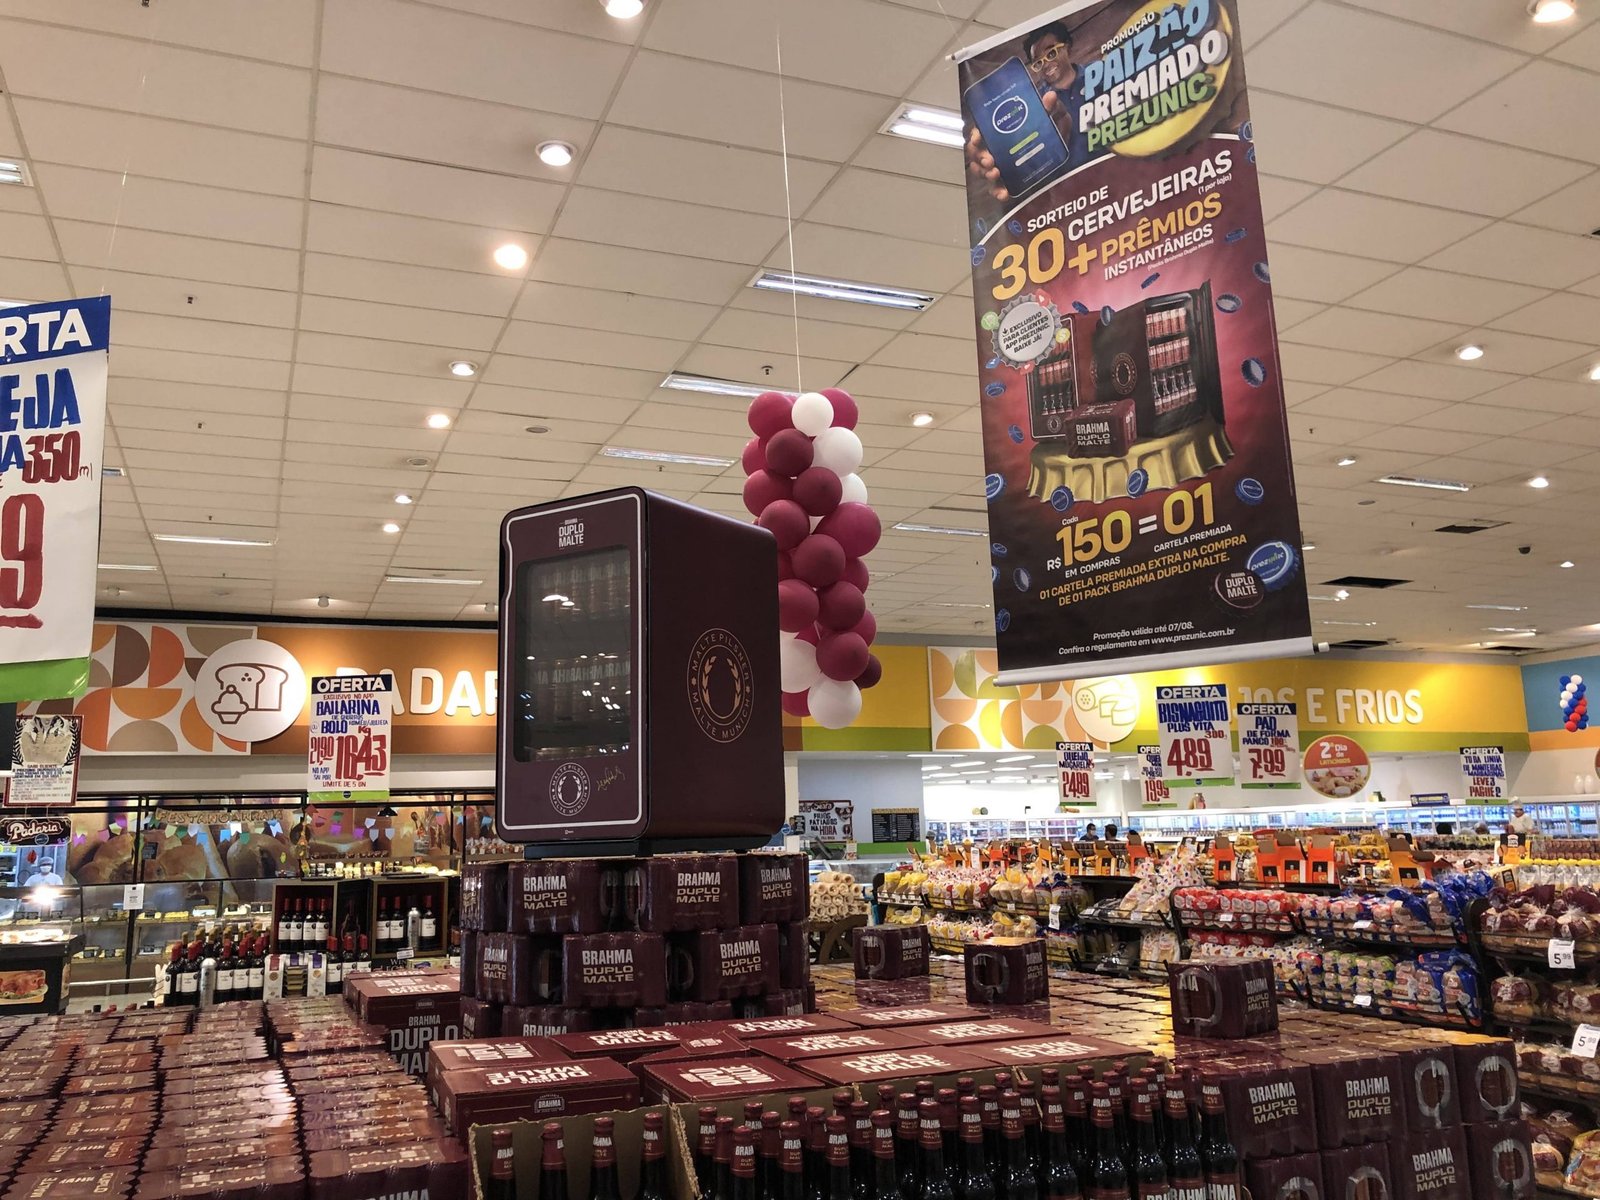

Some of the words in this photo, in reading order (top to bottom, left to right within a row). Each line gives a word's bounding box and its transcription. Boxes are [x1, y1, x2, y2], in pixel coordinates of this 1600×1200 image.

[1101, 12, 1155, 54] PROMOÇÃO
[1080, 30, 1228, 132] PREMIADO
[1088, 73, 1213, 152] PREZUNIC
[1067, 150, 1233, 242] CERVEJEIRAS
[1027, 195, 1088, 233] SORTEIO
[1090, 185, 1109, 207] DE
[1102, 192, 1223, 265] PRÊMIOS
[1104, 224, 1213, 281] INSTANTÂNEOS
[991, 226, 1065, 301] 30
[1003, 331, 1020, 344] PARA
[1020, 315, 1049, 335] CLIENTES
[1010, 311, 1042, 334] EXCLUSIVO
[1005, 339, 1018, 350] APP
[1014, 339, 1032, 353] BAIXE
[1075, 421, 1110, 435] BRAHMA
[1077, 433, 1110, 442] DUPLO
[1077, 438, 1111, 447] MALTE
[1055, 510, 1132, 567] 150
[1162, 482, 1215, 535] 01
[1062, 515, 1079, 526] Cada
[559, 523, 584, 536] DUPLO
[559, 534, 584, 547] MALTE
[1153, 536, 1189, 553] CARTELA
[1190, 524, 1232, 544] PREMIADA
[1039, 589, 1050, 600] 01
[1051, 577, 1094, 596] CARTELA
[1095, 563, 1147, 586] PREMIADA
[1148, 553, 1182, 570] EXTRA
[1183, 549, 1199, 560] NA
[1200, 534, 1247, 556] COMPRA
[1047, 556, 1062, 571] R$
[1065, 569, 1077, 579] EM
[1080, 556, 1120, 575] COMPRAS
[1058, 596, 1072, 607] DE
[1072, 593, 1083, 603] 01
[1084, 585, 1110, 600] PACK
[1112, 572, 1156, 592] BRAHMA
[1157, 562, 1191, 580] DUPLO
[1192, 551, 1231, 570] MALTE.
[1225, 576, 1255, 589] DUPLO
[1227, 585, 1258, 598] MALTE
[1093, 630, 1130, 641] Promoção
[1131, 627, 1153, 637] válida
[1154, 625, 1167, 634] até
[1058, 645, 1085, 655] Confira
[1091, 639, 1138, 654] regulamento
[1151, 628, 1236, 644] www.prezunic.com.br
[692, 634, 717, 671] MALTE
[719, 634, 749, 680] PILSNER
[317, 678, 385, 693] OFERTA
[1161, 687, 1221, 699] OFERTA
[316, 700, 380, 716] BAILARINA
[1241, 705, 1291, 714] OFERTA
[1306, 688, 1327, 723] E
[1336, 689, 1424, 724] FRIOS
[692, 692, 717, 736] MALTE
[722, 699, 750, 738] MUNICH
[321, 720, 348, 734] BOLO
[1167, 722, 1190, 733] PLUS
[1194, 721, 1215, 731] VITA
[1247, 730, 1258, 738] DE
[1260, 730, 1291, 738] FORMA
[1473, 777, 1489, 785] LEVE
[10, 822, 58, 840] Padaria
[677, 872, 721, 886] BRAHMA
[761, 867, 791, 883] BRAHMA
[523, 876, 566, 891] BRAHMA
[762, 882, 792, 893] DUPLO
[523, 892, 567, 901] DUPLO
[676, 894, 720, 903] MALTE
[677, 887, 721, 896] DUPLO
[762, 890, 792, 900] MALTE
[524, 899, 568, 910] MALTE
[484, 947, 508, 963] BRAHMA
[719, 939, 760, 959] BRAHMA
[582, 949, 634, 965] BRAHMA
[721, 956, 761, 969] DUPLO
[483, 962, 507, 972] DUPLO
[583, 965, 634, 975] DUPLO
[722, 964, 761, 977] MALTE
[483, 970, 507, 980] MALTE
[583, 973, 634, 983] MALTE
[408, 1015, 441, 1027] BRAHMA
[523, 1024, 567, 1036] BRAHMA
[1249, 1081, 1295, 1104] BRAHMA
[1346, 1076, 1390, 1097] BRAHMA
[538, 1099, 562, 1109] BRAHMA
[1252, 1099, 1297, 1115] DUPLO
[1348, 1096, 1391, 1109] DUPLO
[1254, 1107, 1299, 1125] MALTE
[1348, 1105, 1391, 1119] MALTE
[1412, 1148, 1454, 1171] BRAHMA
[1415, 1166, 1455, 1183] DUPLO
[1416, 1175, 1456, 1192] MALTE
